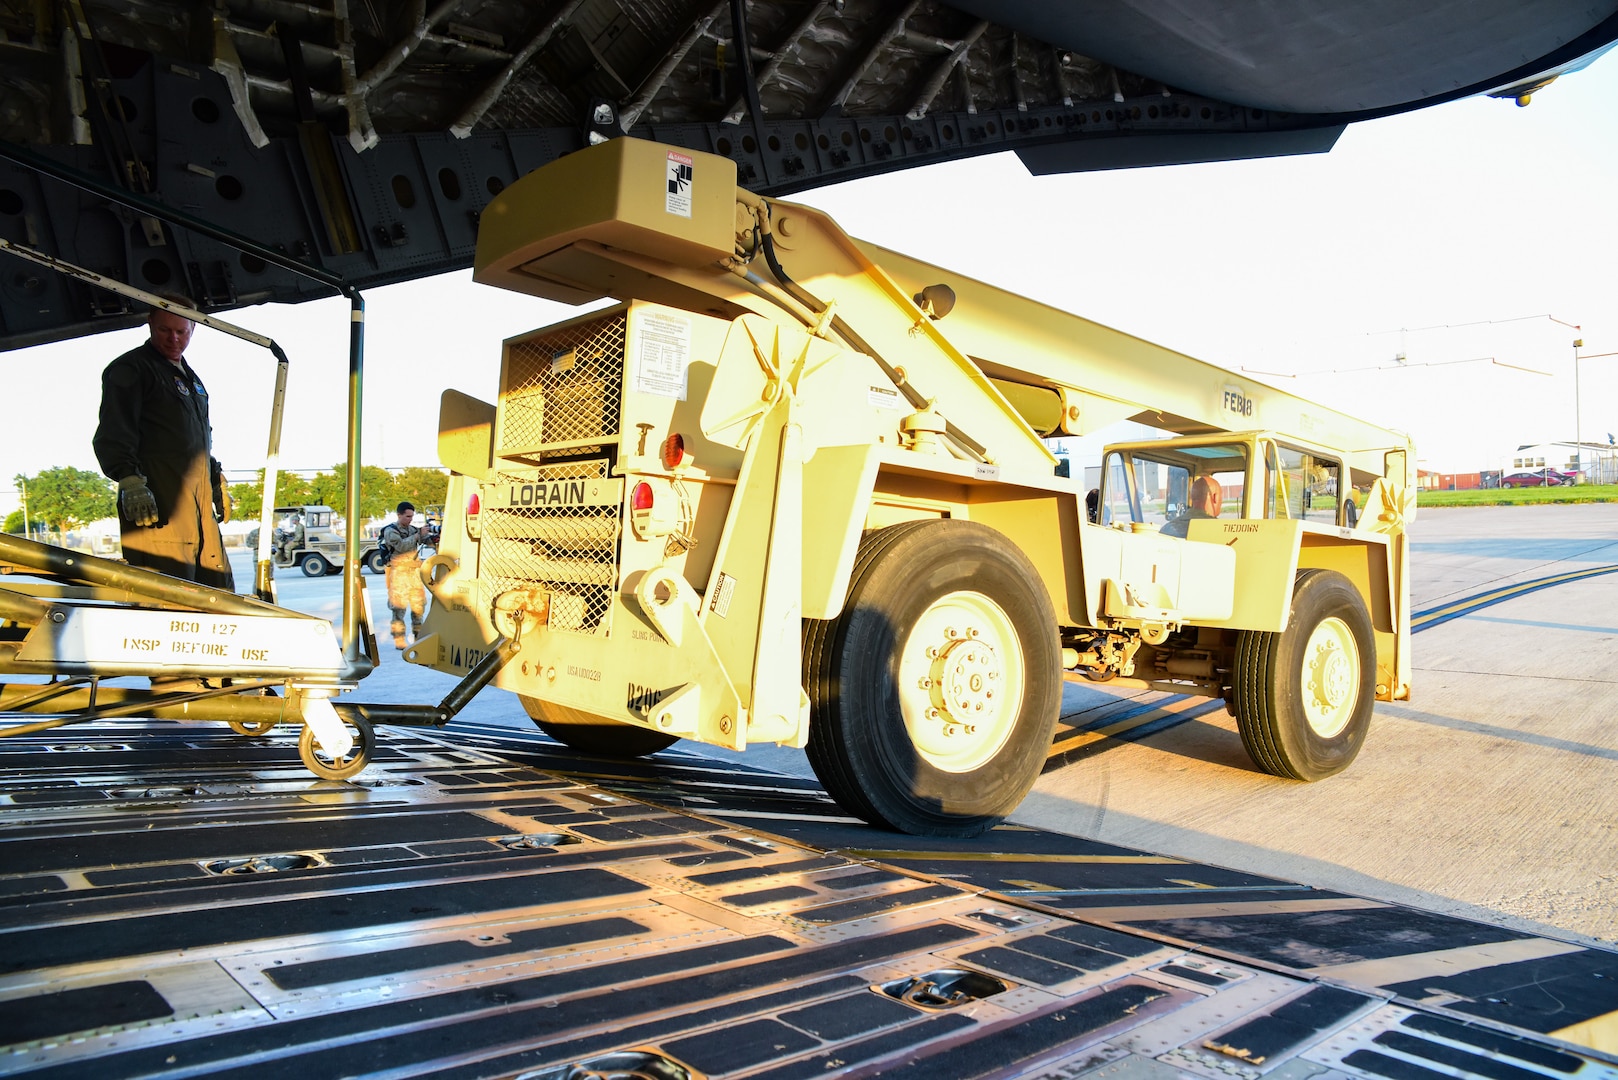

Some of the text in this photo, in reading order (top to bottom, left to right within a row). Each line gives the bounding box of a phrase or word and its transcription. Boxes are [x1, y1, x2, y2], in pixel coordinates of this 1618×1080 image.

[510, 481, 585, 506] LORAIN
[712, 574, 725, 603] CAUTION
[170, 620, 238, 636] BCO 127
[123, 638, 269, 661] INSP BEFORE USE
